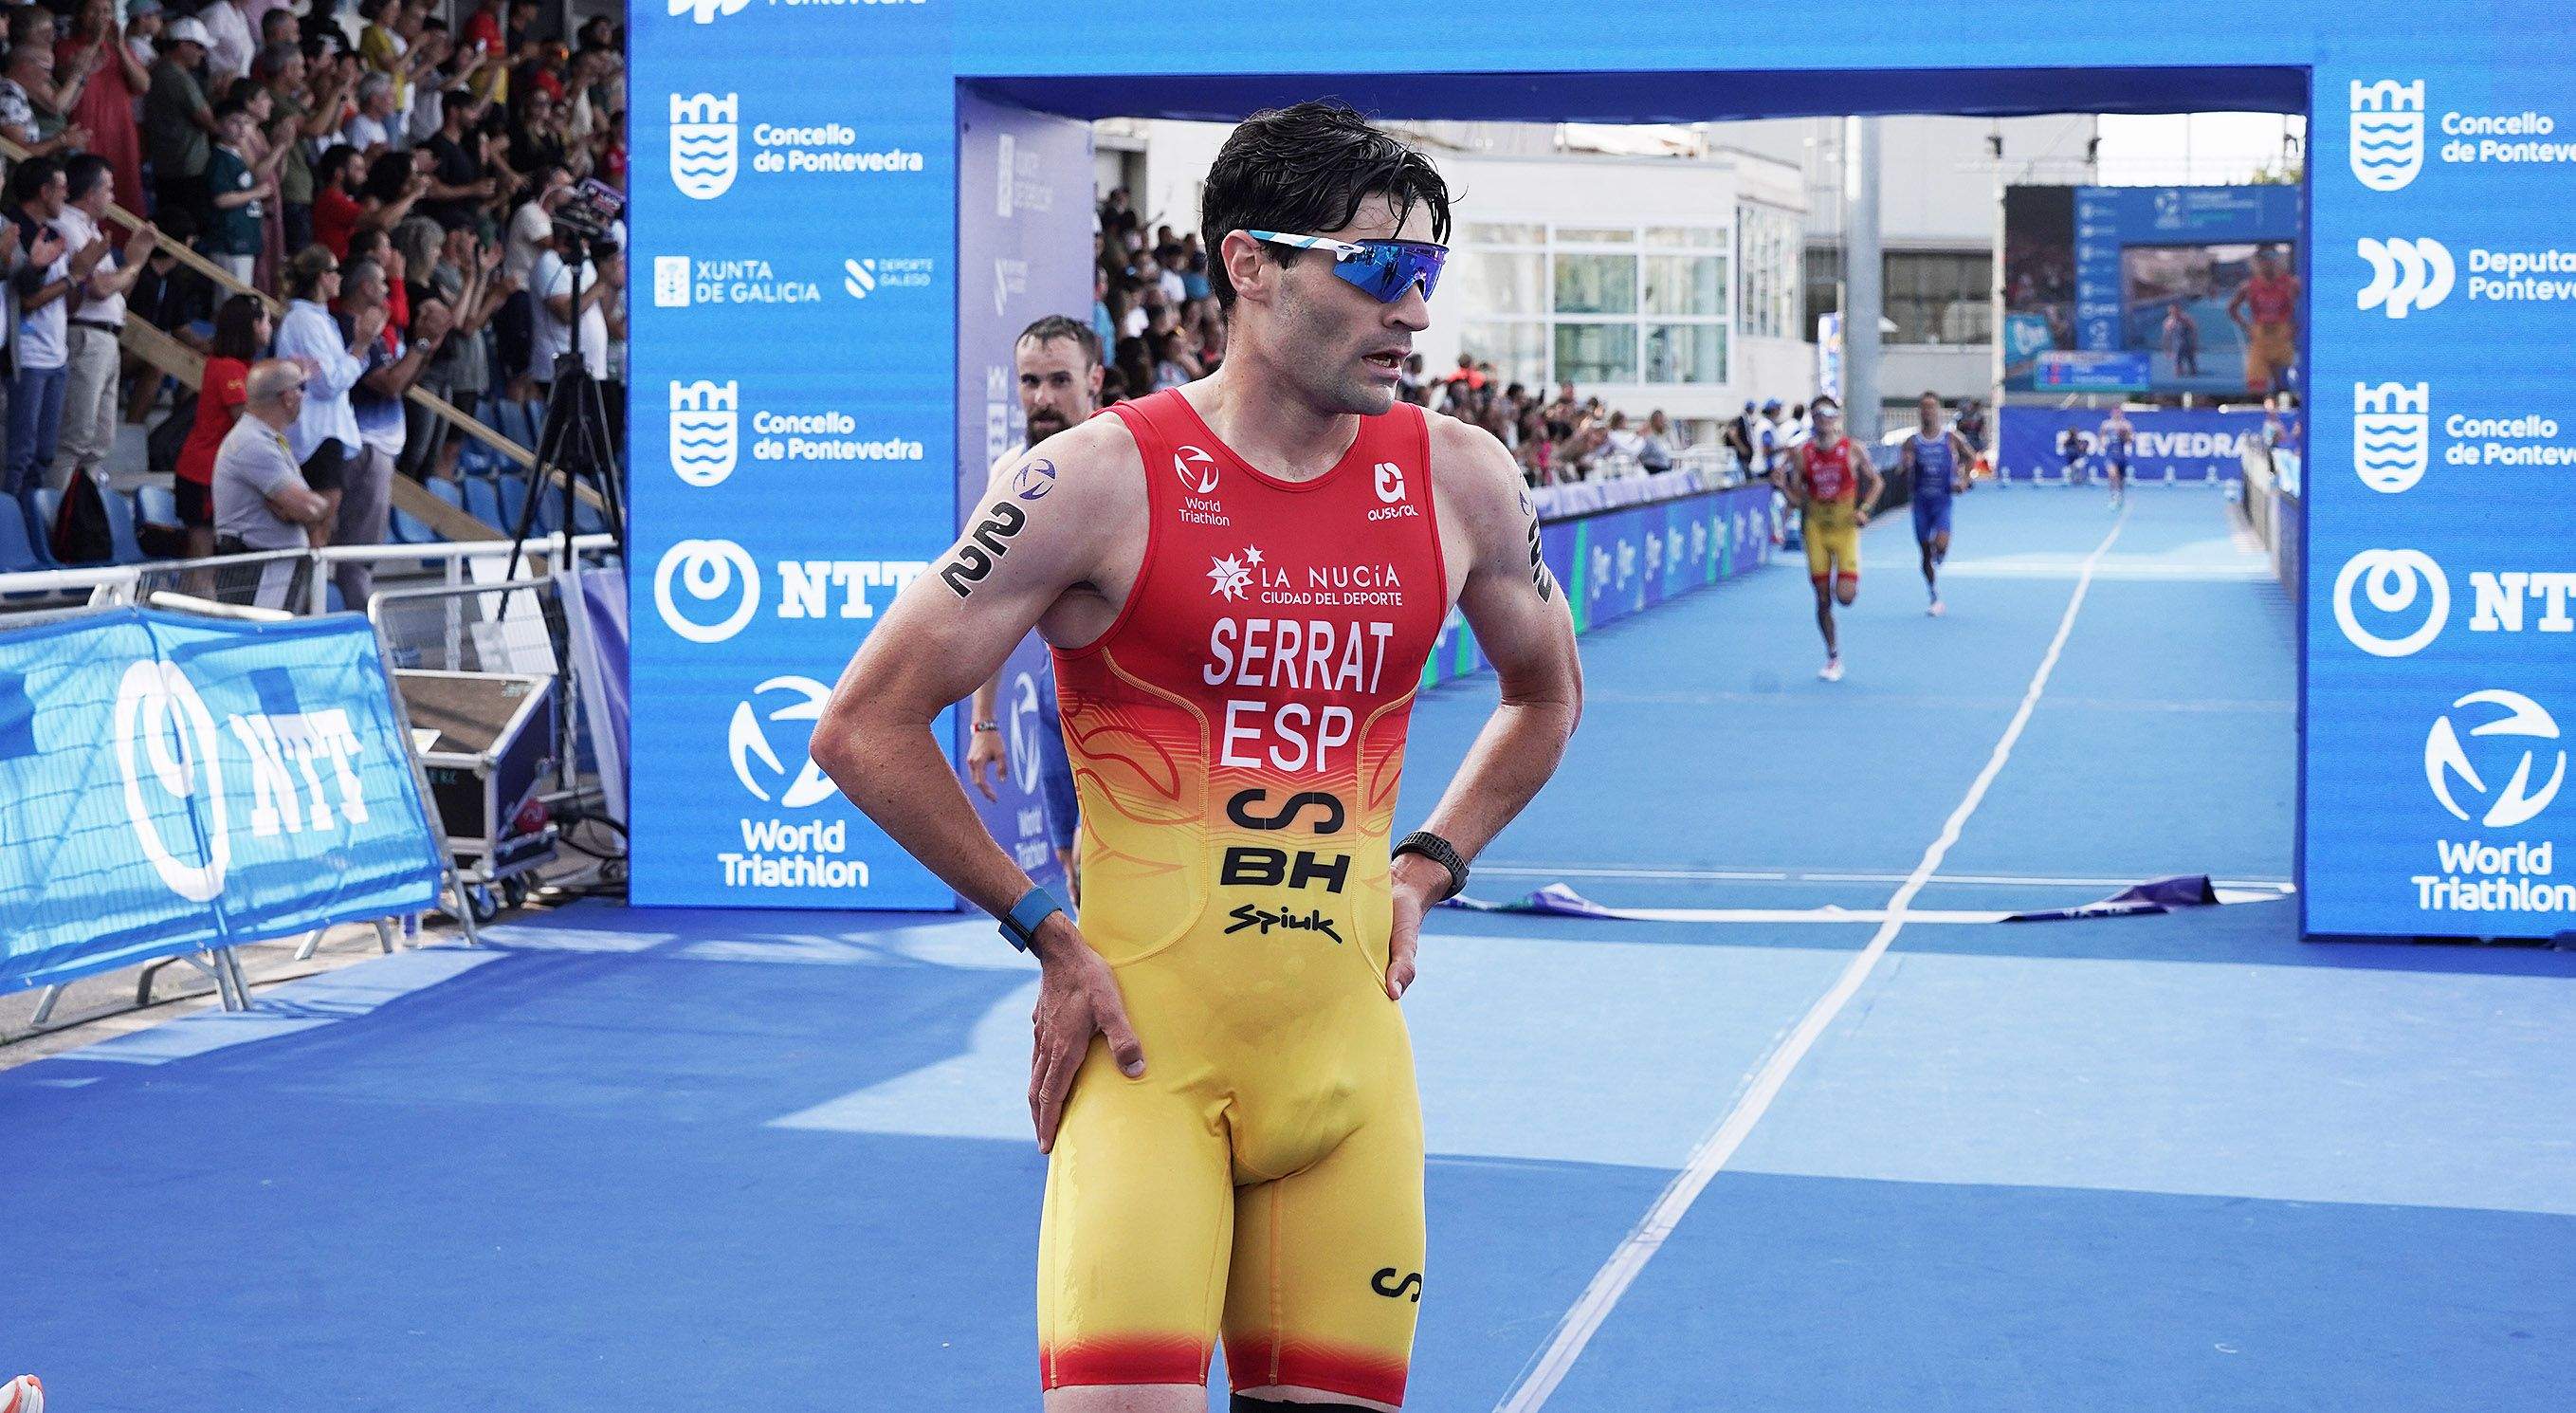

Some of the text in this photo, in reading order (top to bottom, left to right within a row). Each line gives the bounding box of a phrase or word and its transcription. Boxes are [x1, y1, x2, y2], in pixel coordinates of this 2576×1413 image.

[753, 123, 856, 147] Concello
[2440, 111, 2554, 136] Concello
[753, 149, 924, 173] de Pontevedra
[2440, 139, 2476, 163] de
[695, 261, 774, 282] XUNTA
[2468, 248, 2576, 279] Deputa
[695, 283, 822, 303] DE GALICIA
[753, 411, 856, 434] Concello
[2445, 413, 2559, 439] Concello
[753, 436, 923, 461] de Pontevedra
[2445, 442, 2576, 466] de Pontev
[1185, 496, 1221, 513] World
[1367, 504, 1419, 522] austral
[1178, 508, 1231, 527] Triathlon
[940, 501, 1027, 598] 22
[1262, 566, 1291, 589] LA
[1261, 591, 1403, 607] CIUDAD DEL DEPORTE
[1202, 616, 1395, 694] SERRAT
[1219, 699, 1354, 773] ESP
[228, 707, 370, 837] NTT
[740, 818, 846, 853] World
[2437, 839, 2553, 875] World
[718, 853, 869, 888] Triathlon
[1220, 847, 1351, 894] BH
[2411, 876, 2576, 912] Triathlon
[1224, 904, 1343, 945] Spiuk
